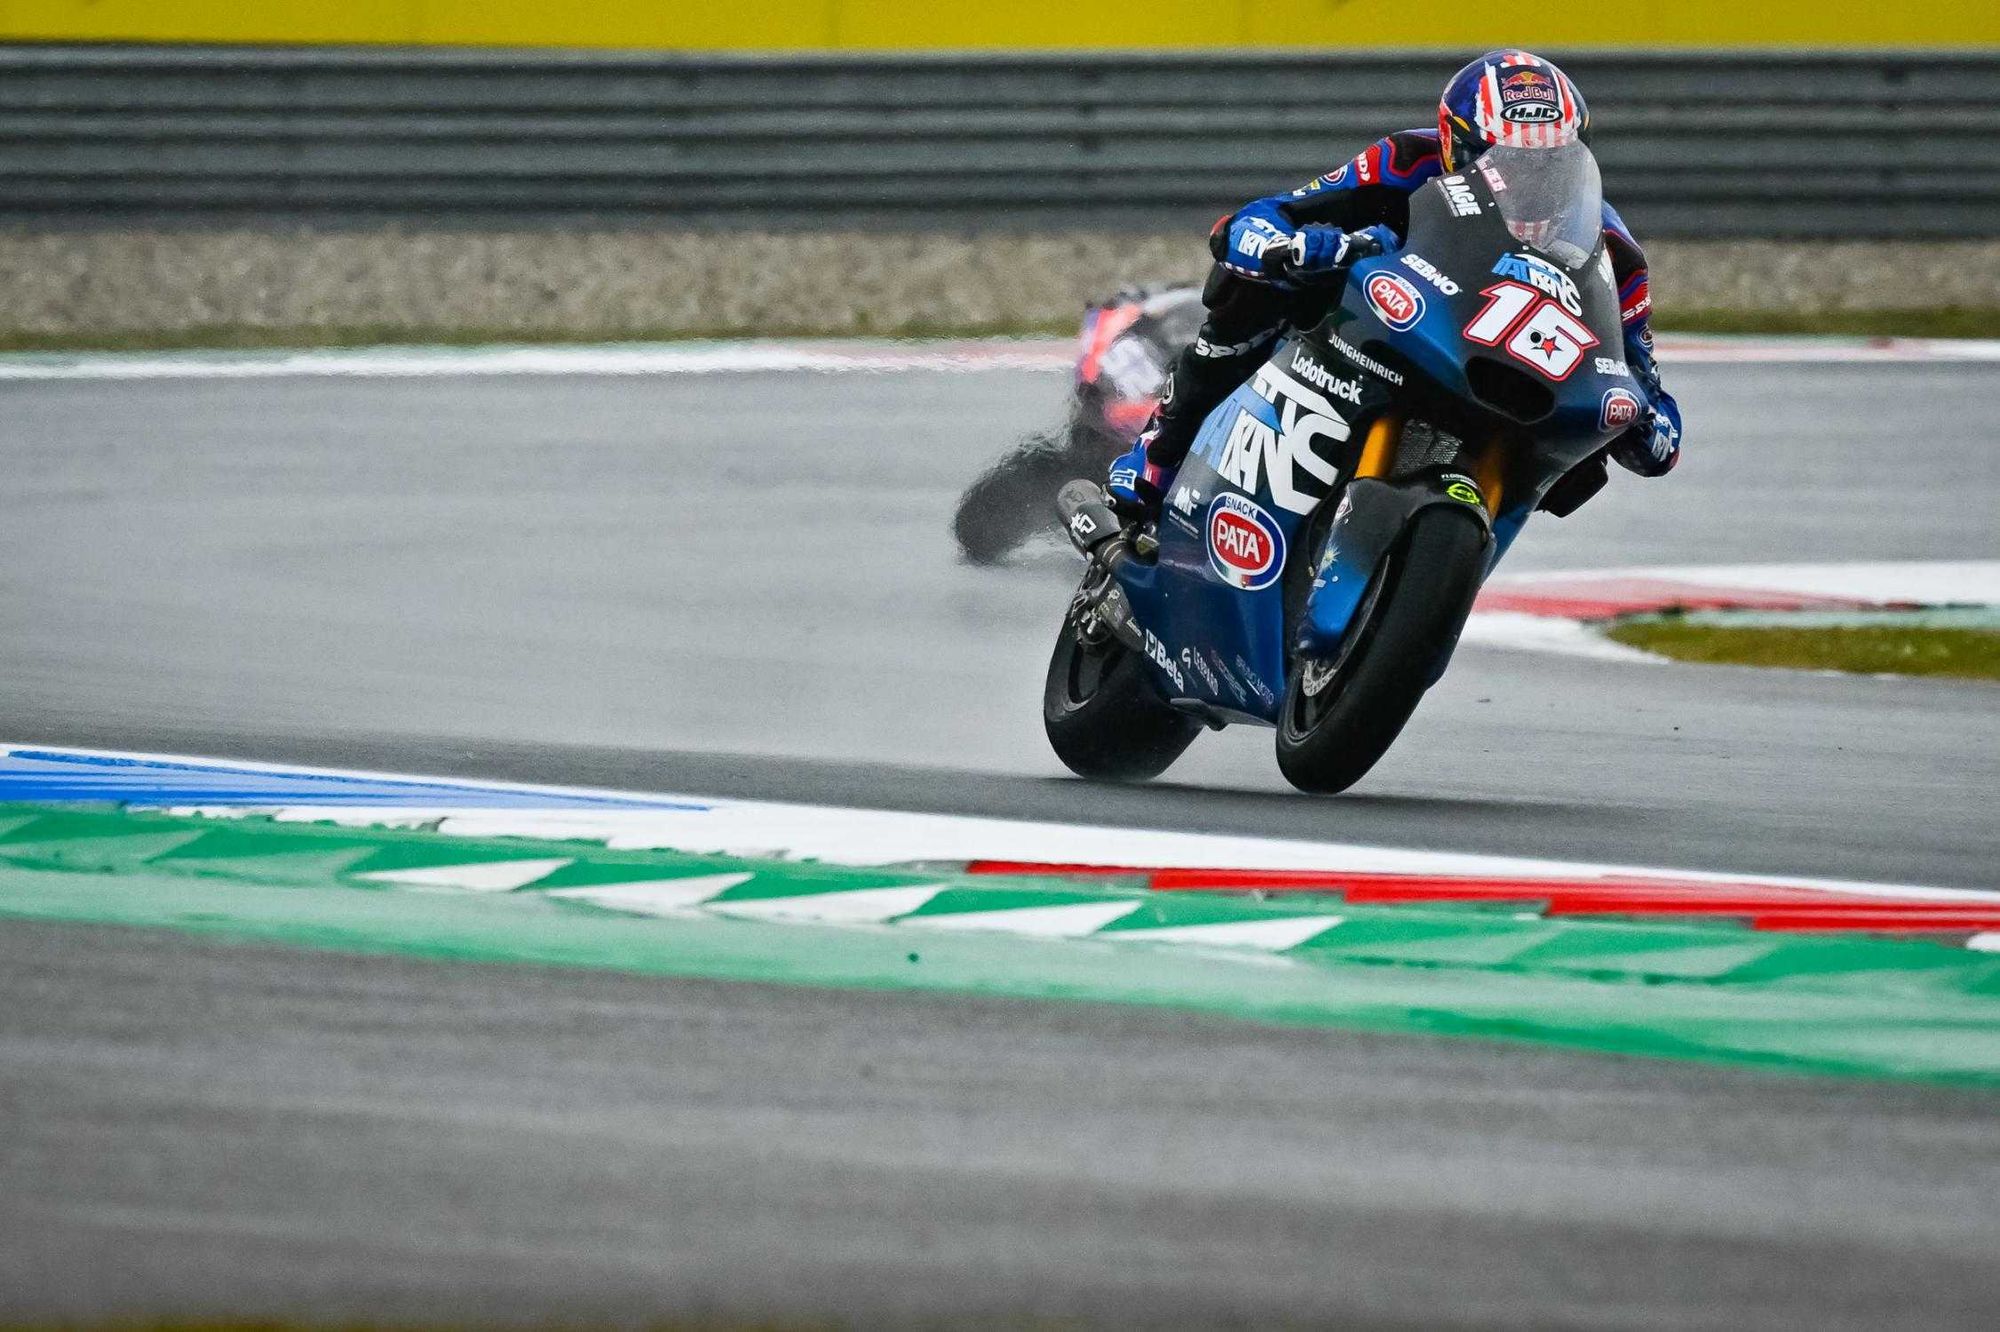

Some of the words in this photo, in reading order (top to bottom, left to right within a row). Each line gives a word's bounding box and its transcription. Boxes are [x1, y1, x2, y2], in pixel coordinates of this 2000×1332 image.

[1503, 86, 1531, 102] Red
[1532, 87, 1557, 102] Bull
[1509, 107, 1556, 119] HJC
[1374, 281, 1409, 318] PATA
[1462, 280, 1600, 382] 16
[1290, 346, 1364, 405] Lodotruck
[1328, 334, 1404, 386] JUNGHEINRICH
[1609, 404, 1632, 420] PATA
[1226, 496, 1256, 519] SNACK
[1216, 518, 1261, 563] PATA
[1157, 640, 1184, 693] Beta
